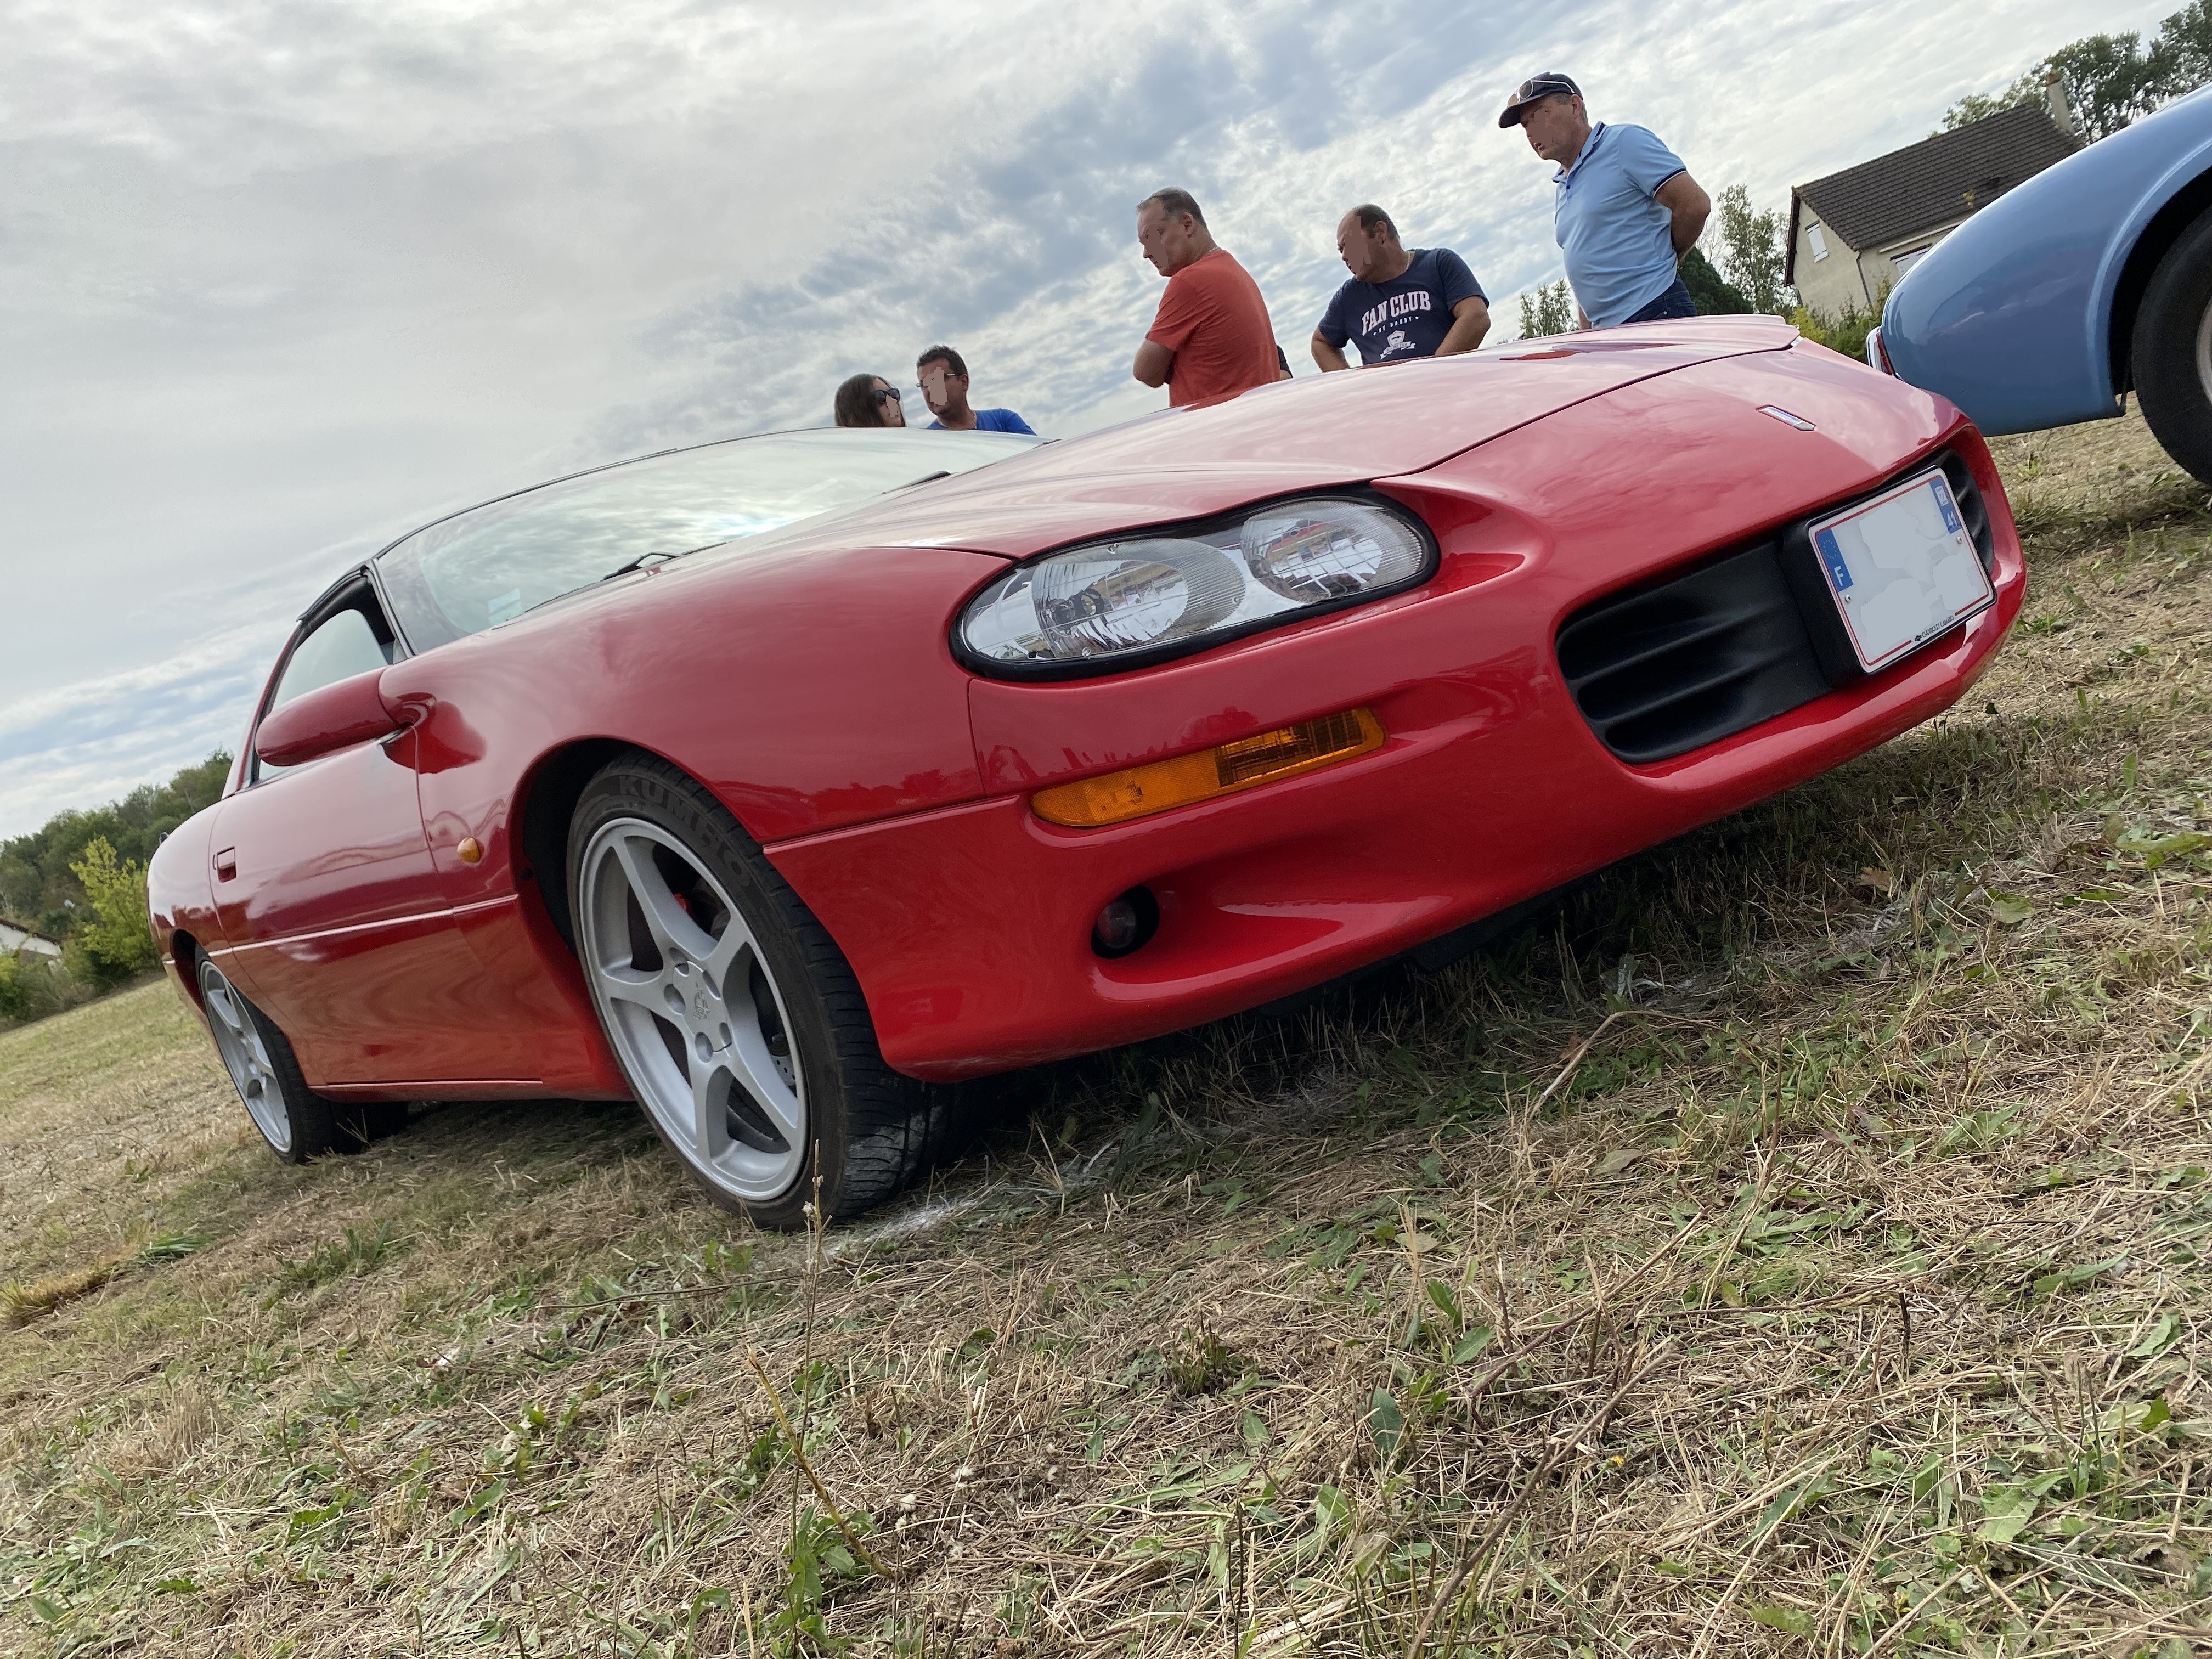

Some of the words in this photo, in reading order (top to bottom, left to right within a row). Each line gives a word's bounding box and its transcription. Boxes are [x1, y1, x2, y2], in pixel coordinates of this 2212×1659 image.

[1362, 300, 1387, 336] FAN
[1390, 290, 1431, 317] CLUB
[1947, 511, 1957, 526] 41
[1834, 566, 1844, 586] F
